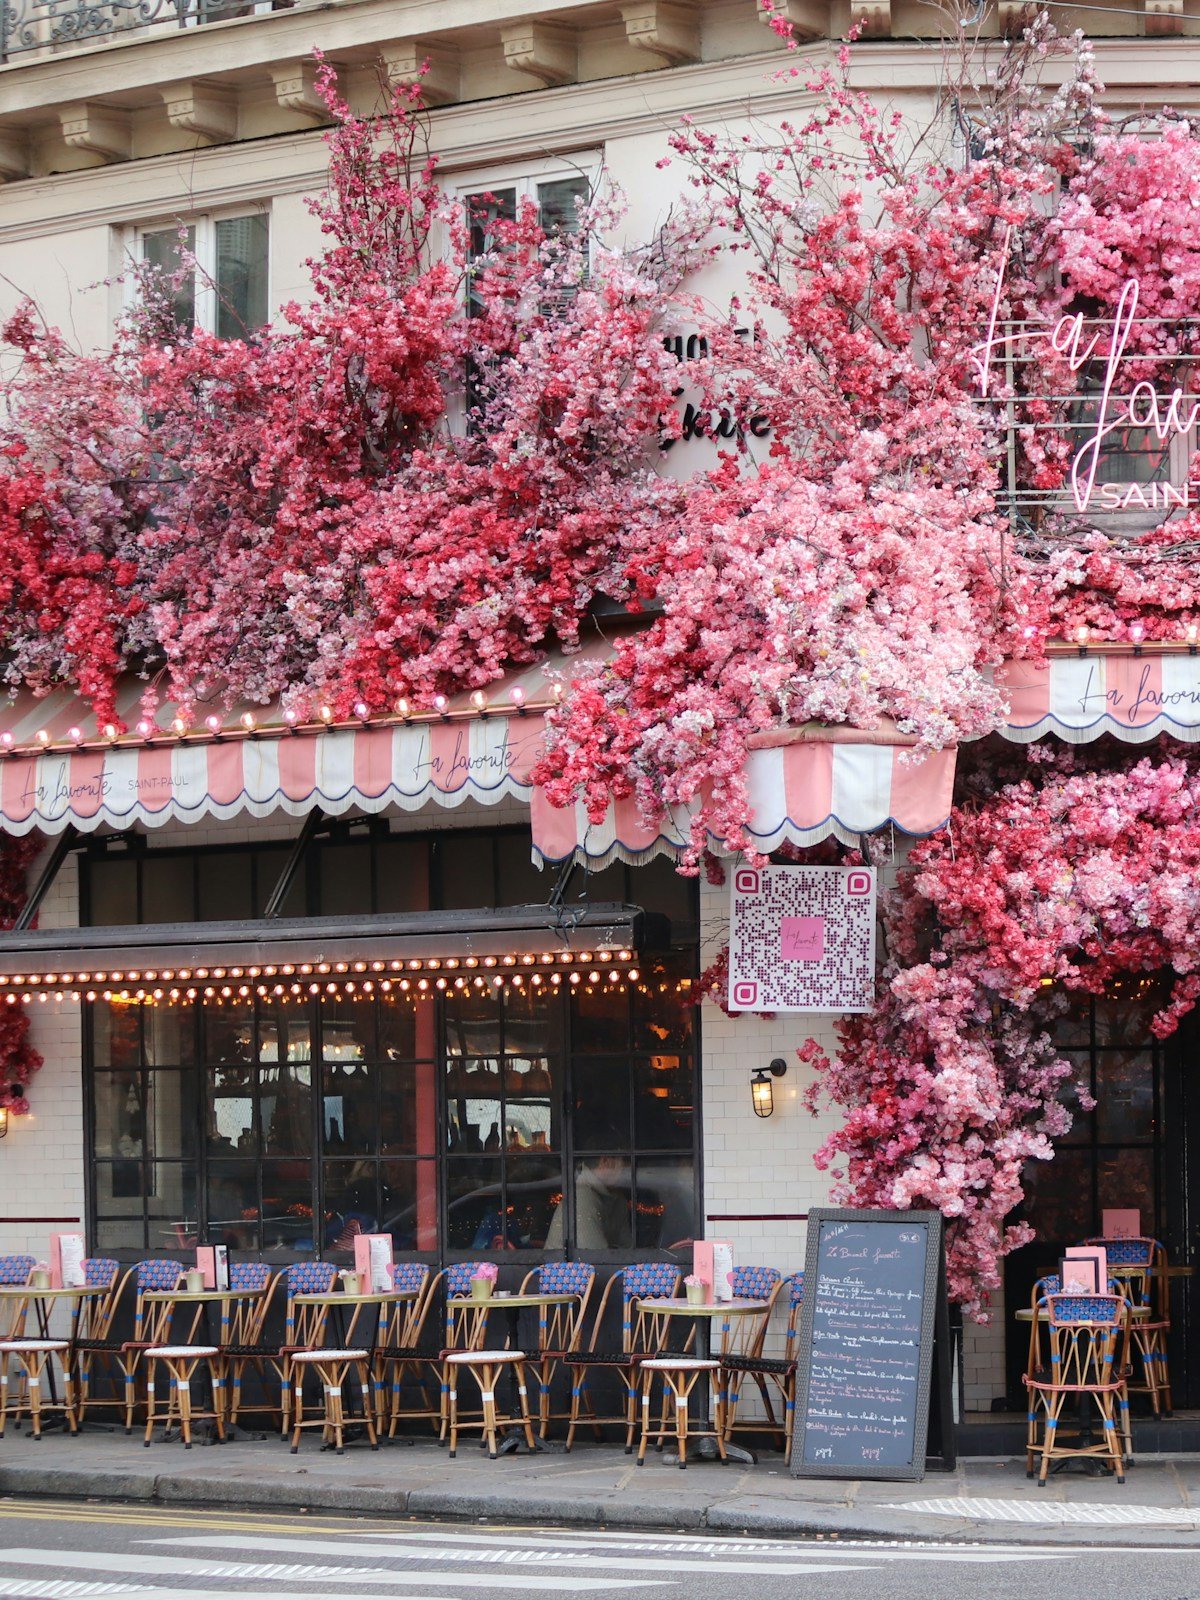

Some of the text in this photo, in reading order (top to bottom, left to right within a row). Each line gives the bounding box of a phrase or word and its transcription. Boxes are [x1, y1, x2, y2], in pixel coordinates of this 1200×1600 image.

[970, 224, 1101, 399] La
[1078, 665, 1124, 713] La
[412, 728, 519, 788] La favorite
[20, 759, 189, 816] La favorite SAINT-PAUL
